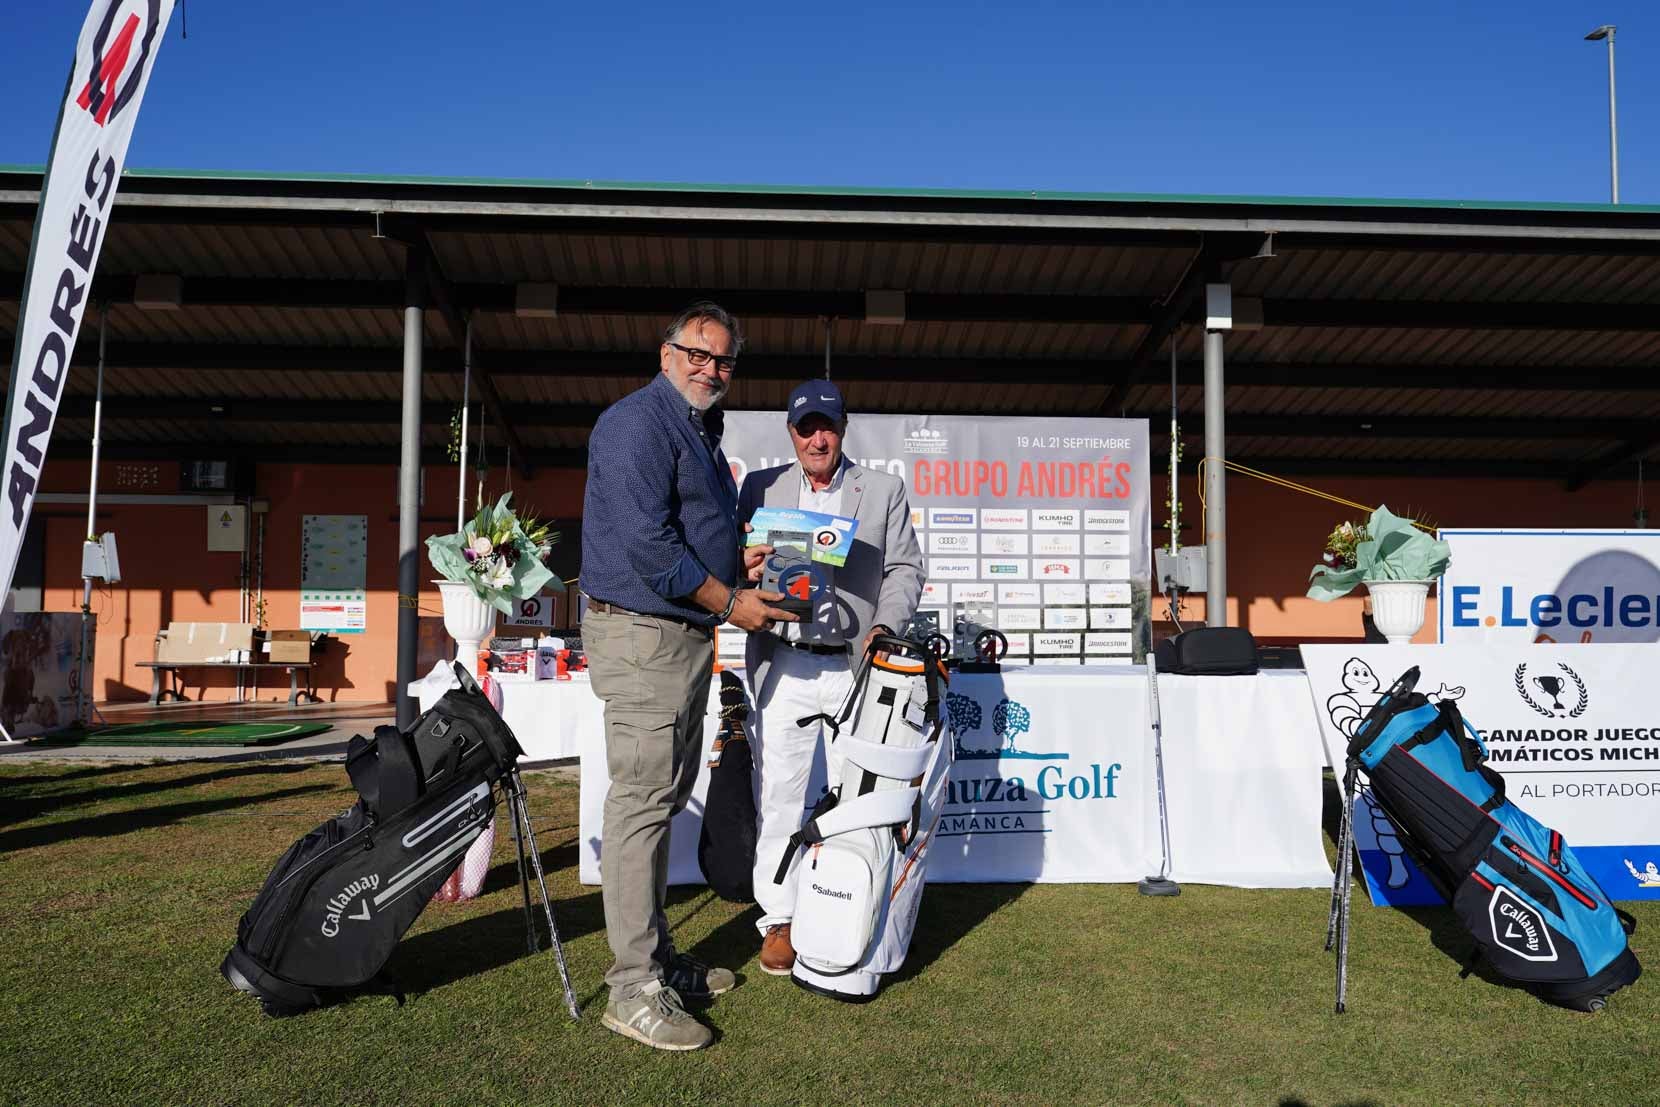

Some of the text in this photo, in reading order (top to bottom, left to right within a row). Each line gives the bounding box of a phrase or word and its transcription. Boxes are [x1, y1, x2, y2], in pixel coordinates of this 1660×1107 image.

[8, 147, 117, 533] ANDRÉS
[1016, 436, 1131, 449] 19 AL 21 SEPTIEMBRE
[913, 458, 1008, 498] GRUPO
[1016, 456, 1131, 499] ANDRÉS
[1452, 585, 1660, 628] E.Lecle
[1486, 746, 1660, 762] MÁTICOS MICH
[1036, 763, 1122, 800] Golf
[1520, 783, 1660, 798] AL PORTADOR
[938, 815, 1025, 832] AMANCA
[321, 873, 380, 938] Callaway
[816, 886, 852, 901] Sabadell
[1500, 902, 1540, 952] Callaway
